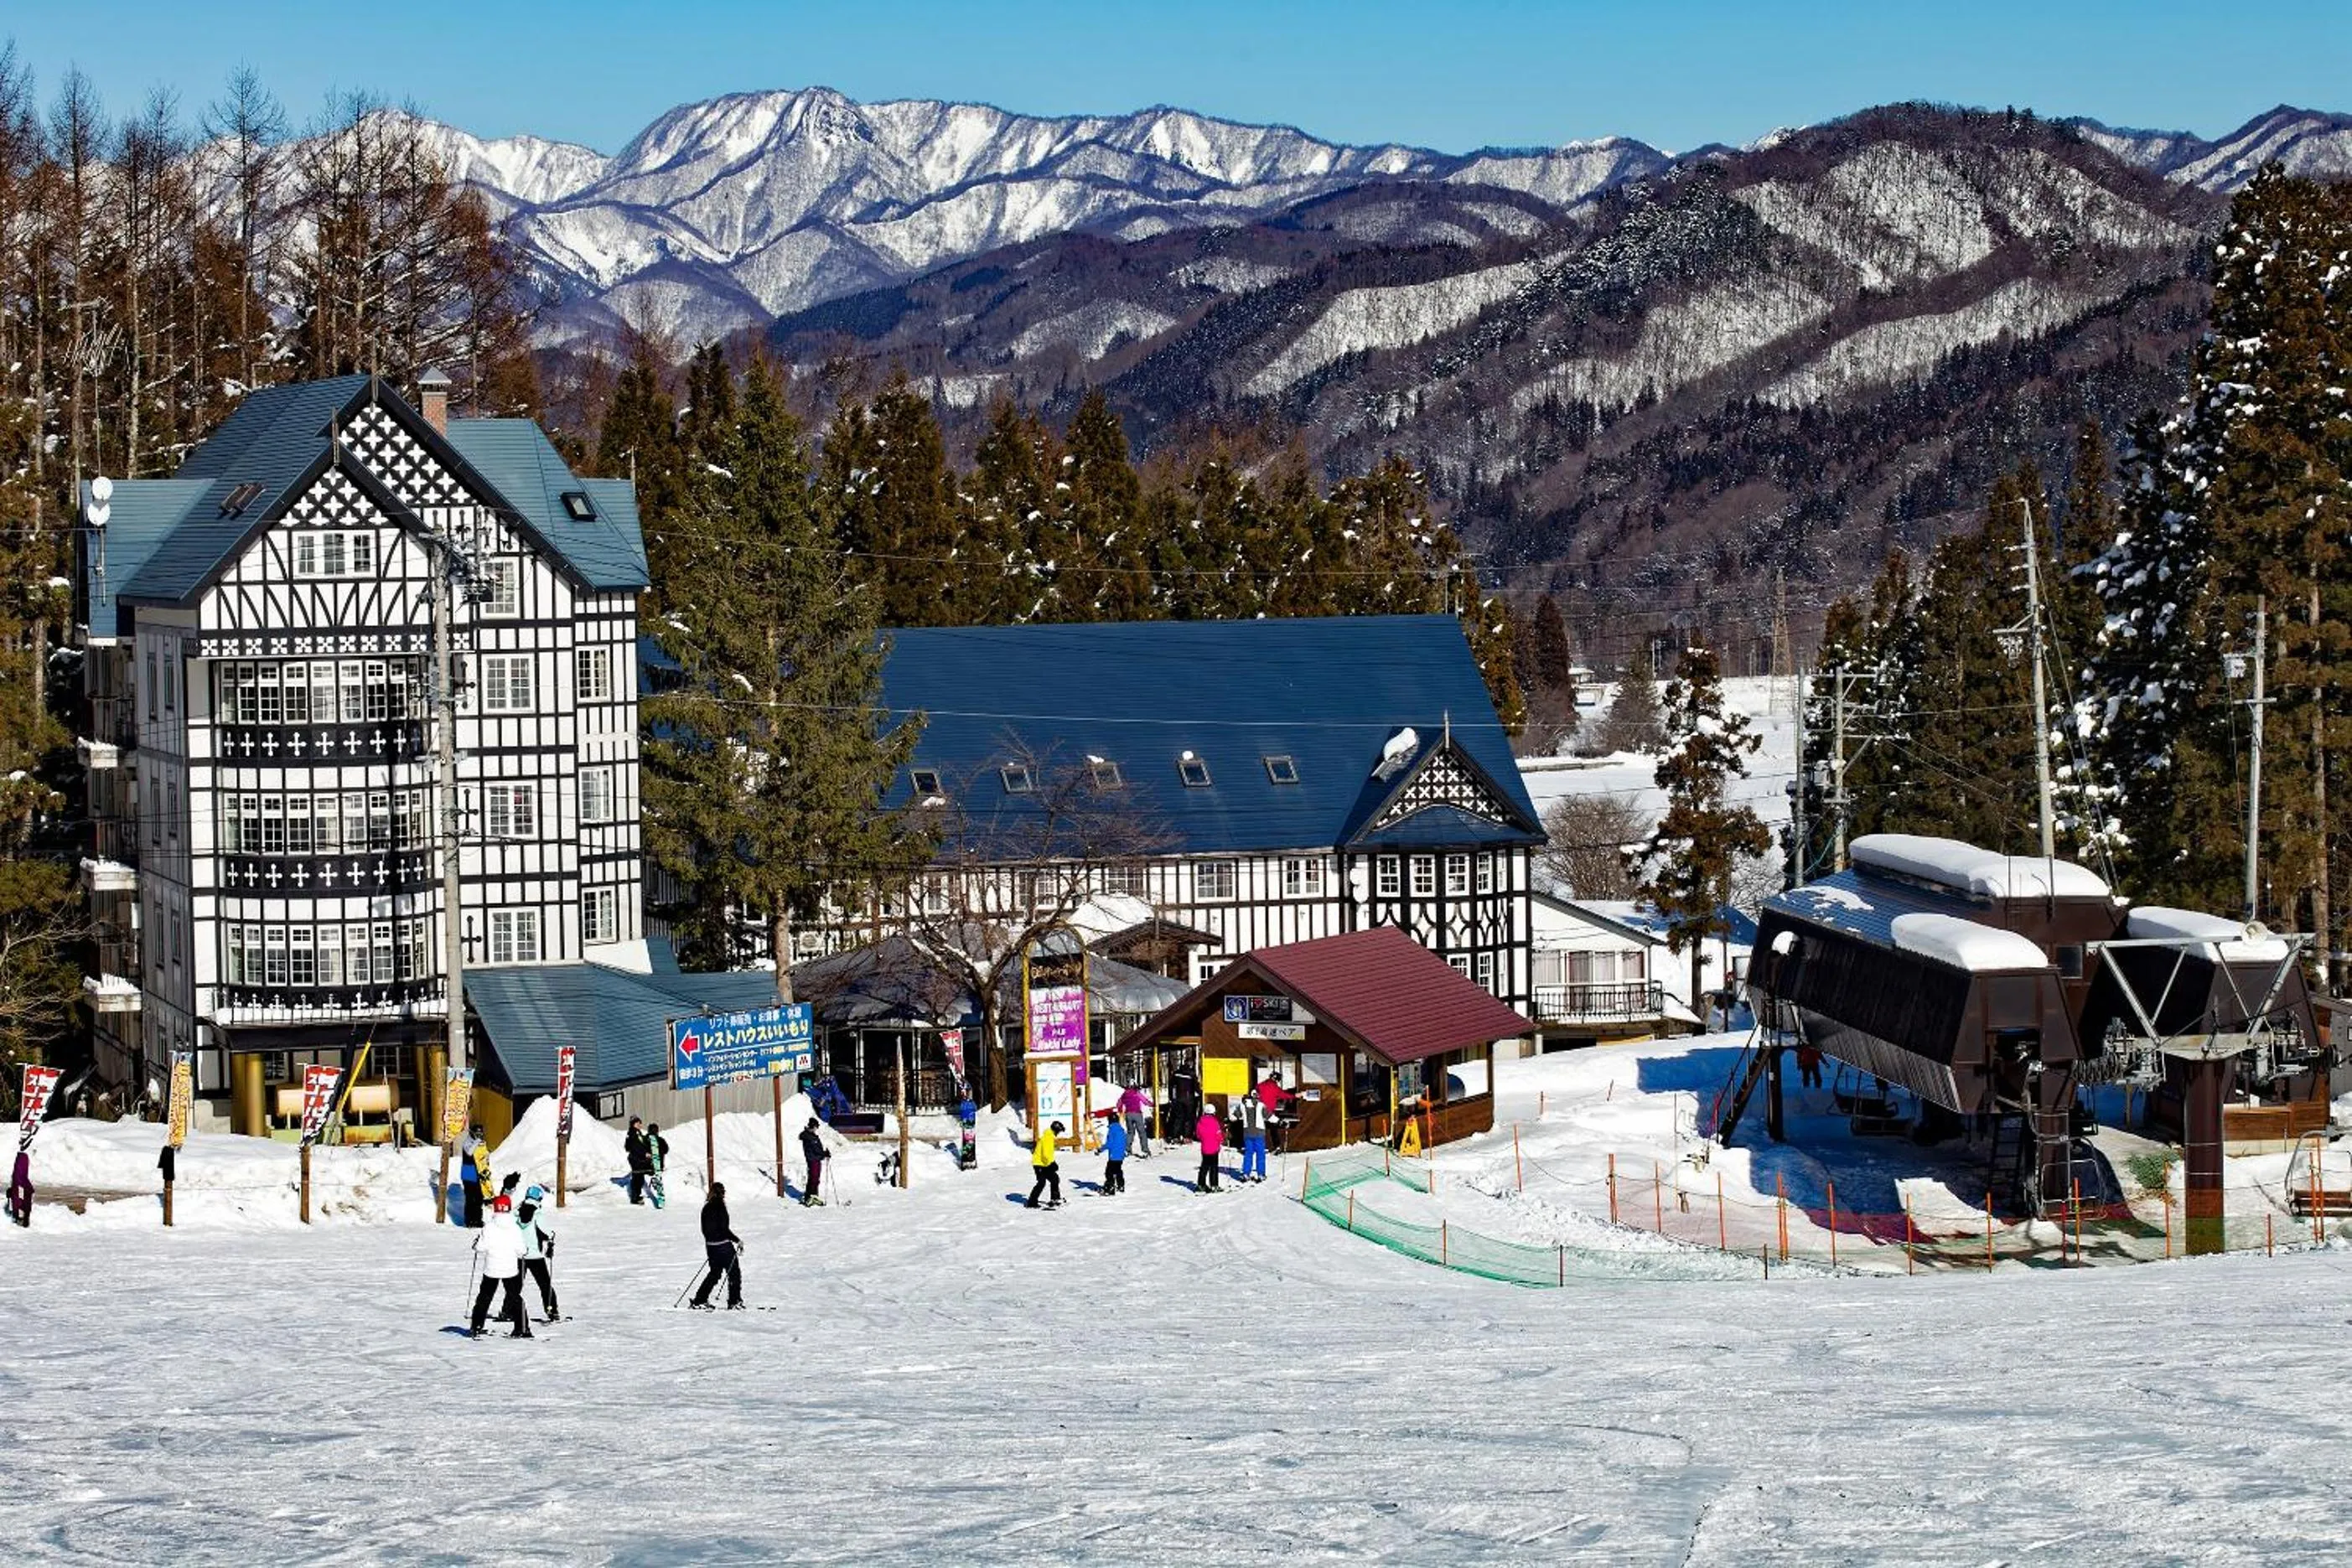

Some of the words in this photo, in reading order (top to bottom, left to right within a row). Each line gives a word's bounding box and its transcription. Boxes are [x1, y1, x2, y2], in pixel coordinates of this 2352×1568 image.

[703, 1019, 809, 1048] レストハウスいいもり
